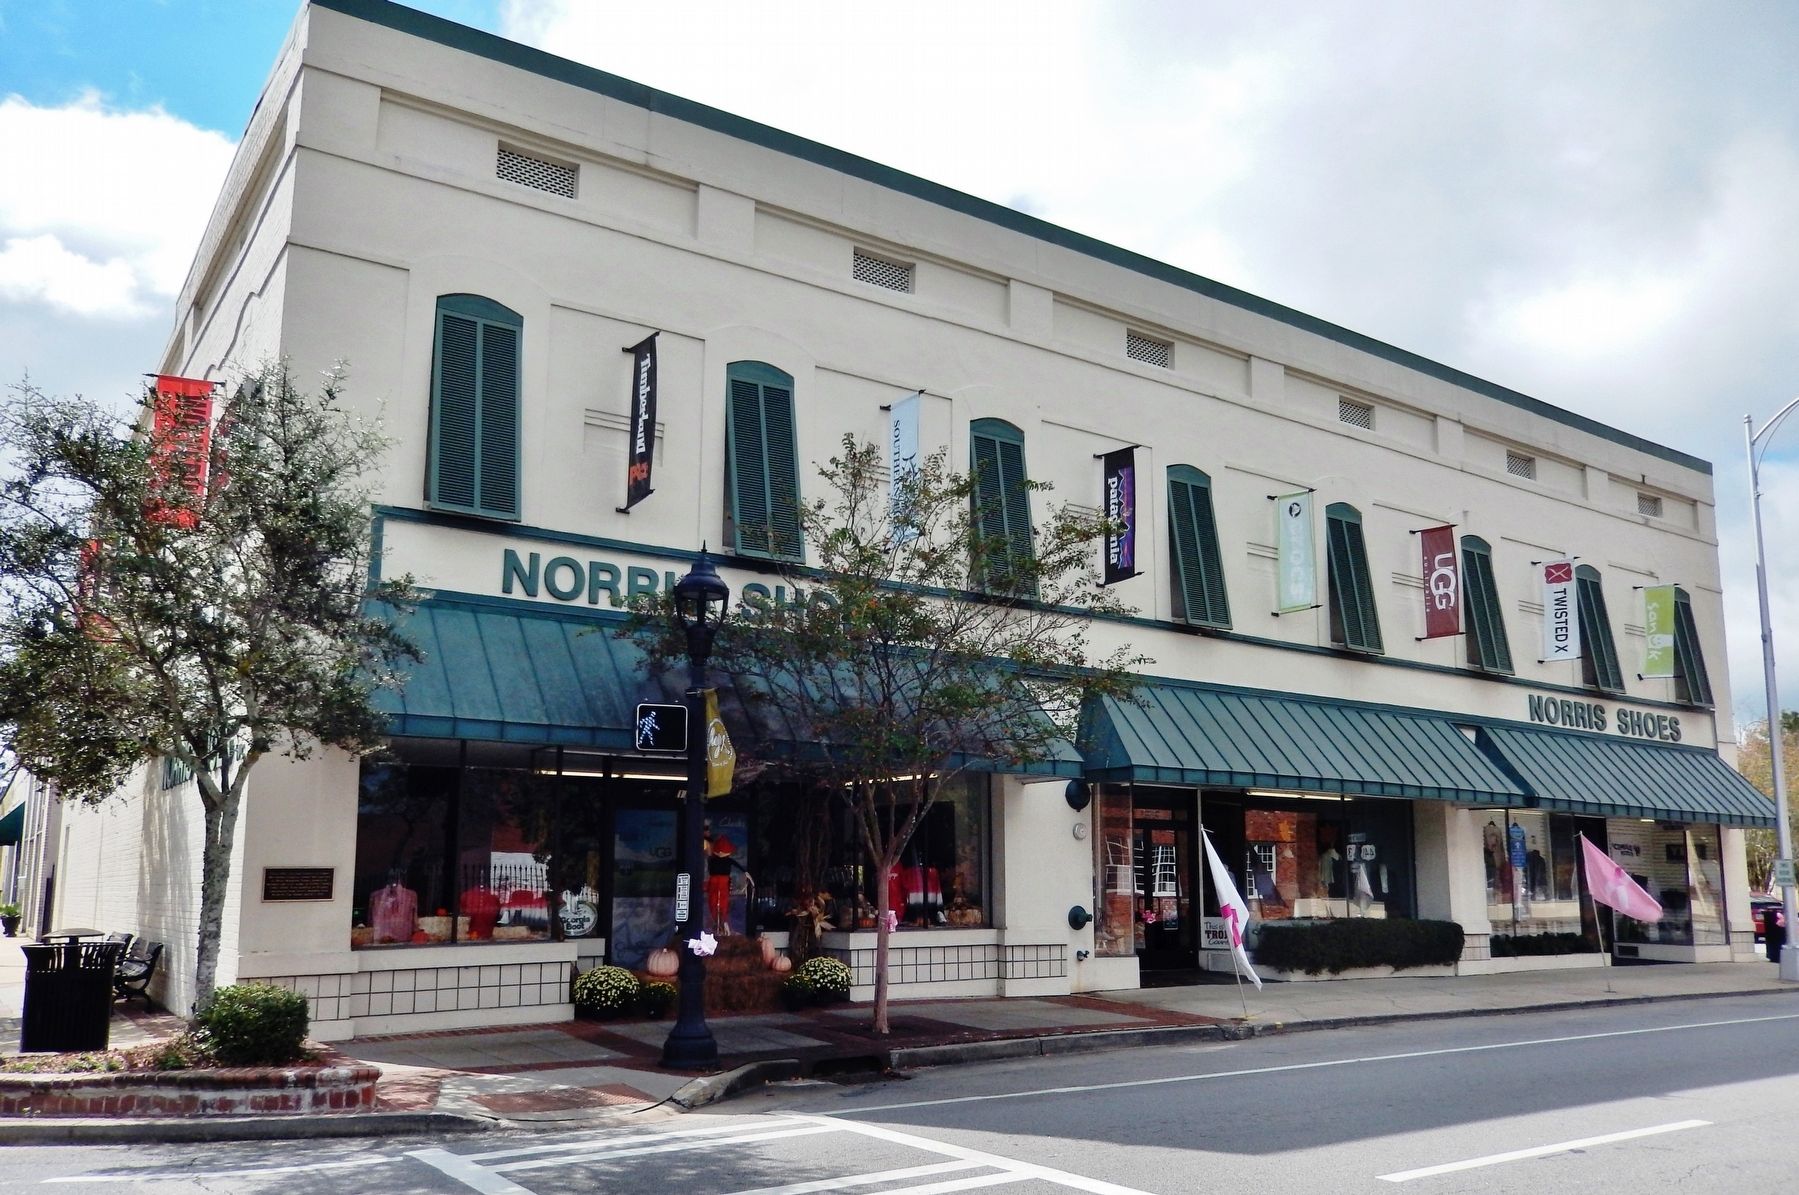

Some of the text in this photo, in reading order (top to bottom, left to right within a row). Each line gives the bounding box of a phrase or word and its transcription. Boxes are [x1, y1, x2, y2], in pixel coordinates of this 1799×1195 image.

[501, 548, 679, 608] NORRI
[1430, 552, 1456, 610] UGG
[1553, 587, 1568, 653] TWISTED X
[1528, 694, 1682, 742] NORRIS SHOES
[566, 922, 585, 930] Boot
